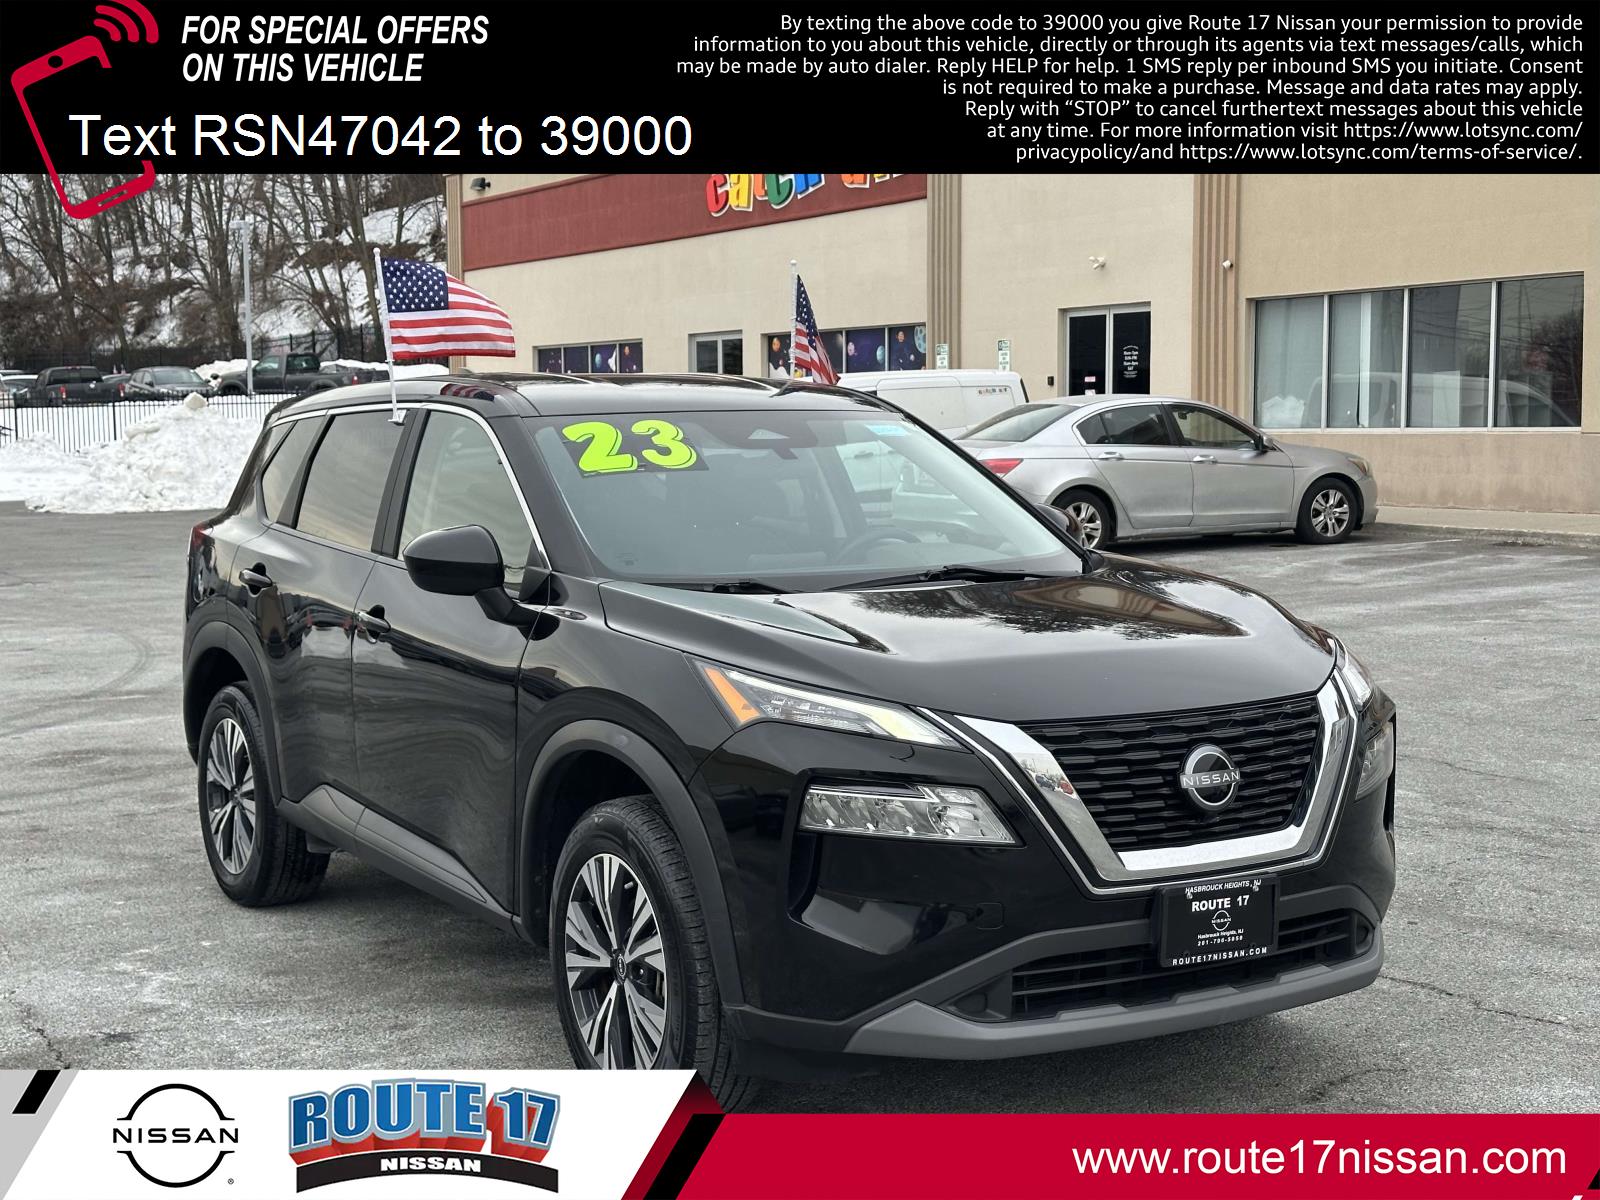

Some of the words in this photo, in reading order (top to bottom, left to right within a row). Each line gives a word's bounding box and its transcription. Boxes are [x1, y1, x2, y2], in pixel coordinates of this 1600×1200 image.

[562, 419, 698, 473] 23
[1183, 771, 1239, 786] NISSAN
[1185, 884, 1223, 894] HASBROUCK
[1191, 897, 1231, 912] ROUTE
[1236, 894, 1250, 906] 17
[1172, 947, 1267, 966] ROUTE17NISSAN.COM
